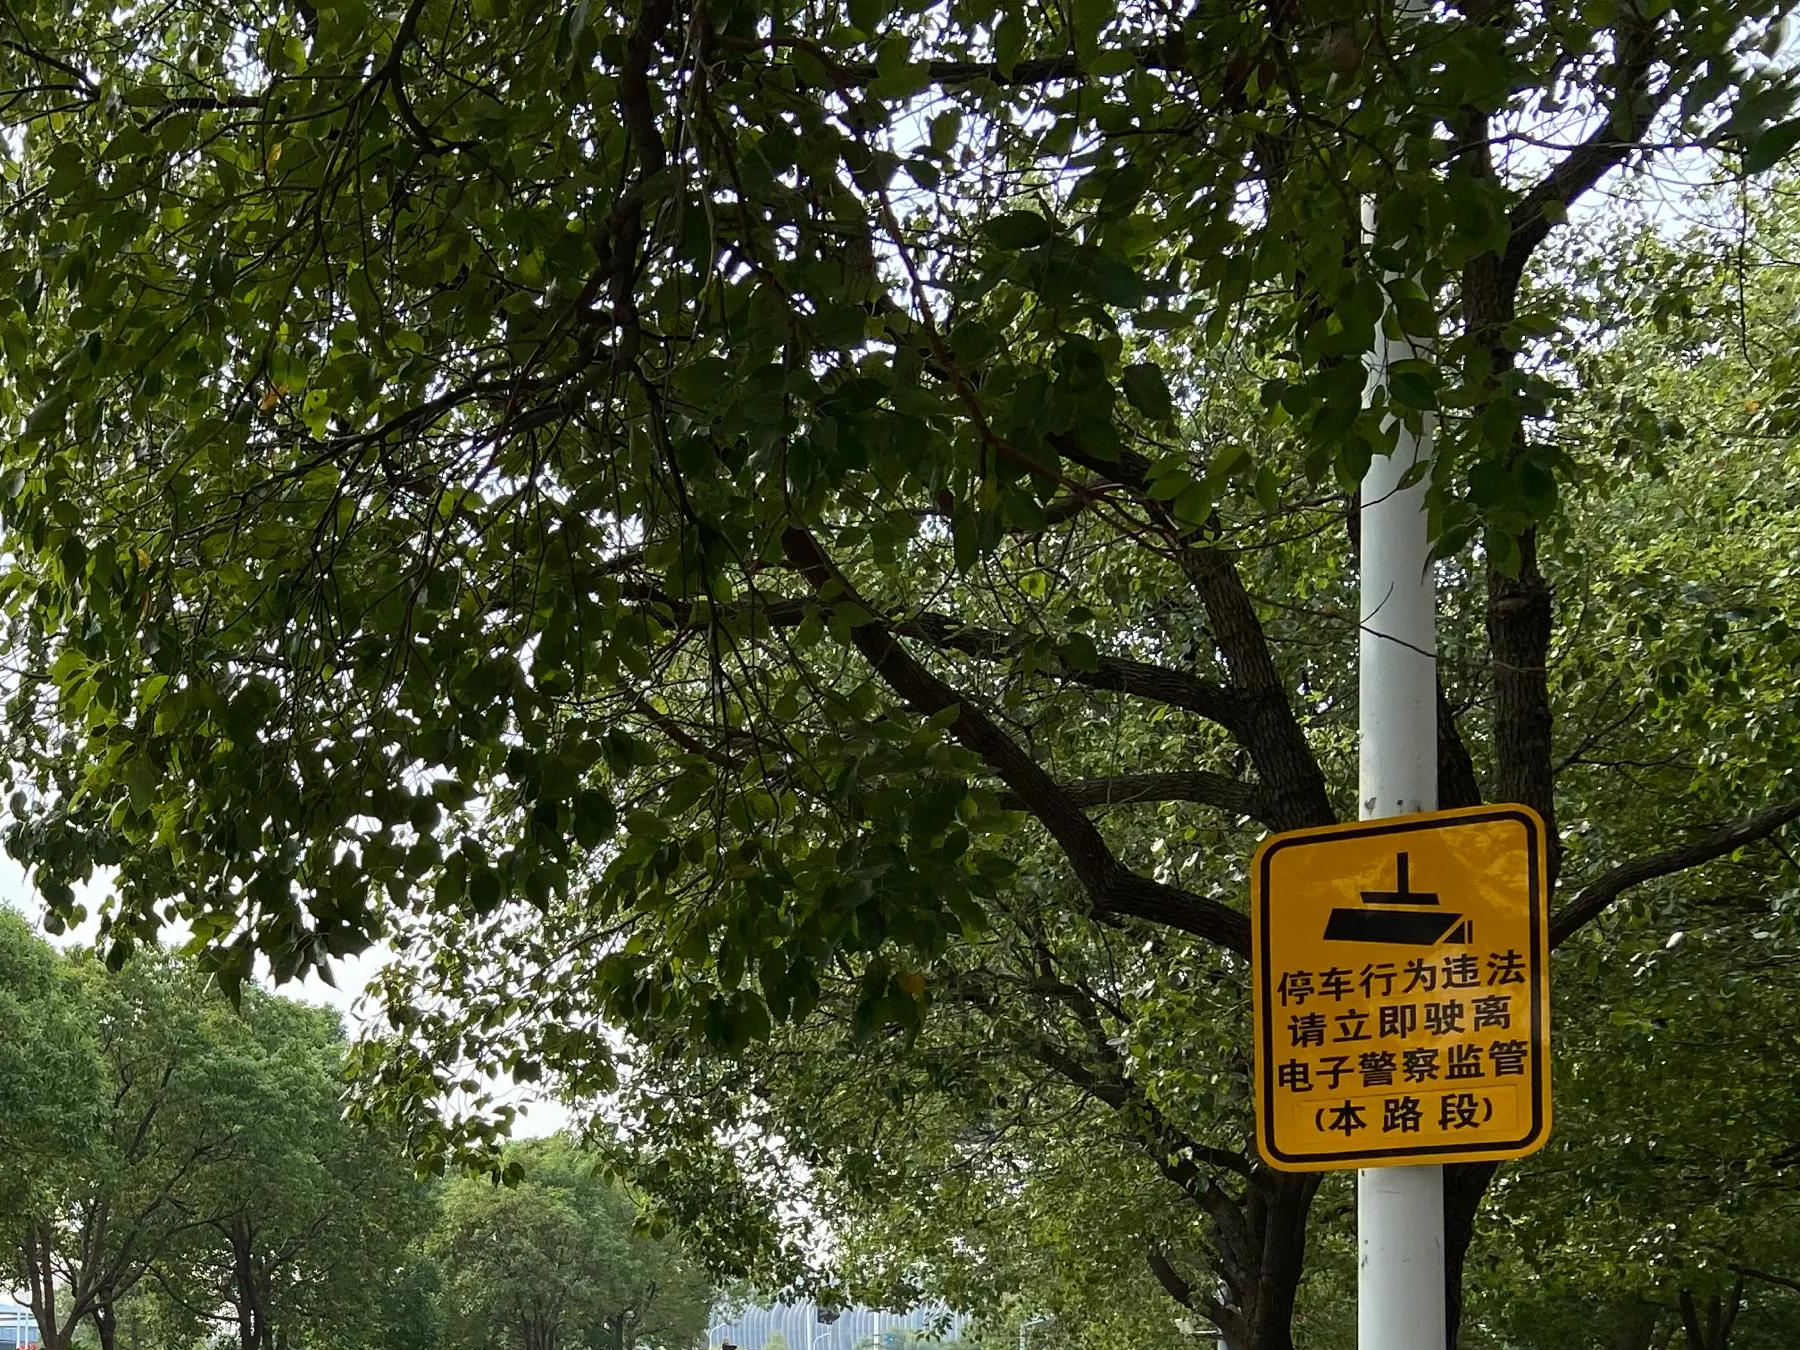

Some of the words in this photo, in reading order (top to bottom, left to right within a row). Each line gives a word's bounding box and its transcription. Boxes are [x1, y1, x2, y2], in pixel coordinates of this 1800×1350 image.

[1277, 949, 1526, 1006] 停车行为违法
[1287, 994, 1512, 1048] 请立即驶离
[1278, 1039, 1528, 1093] 电子警察监管
